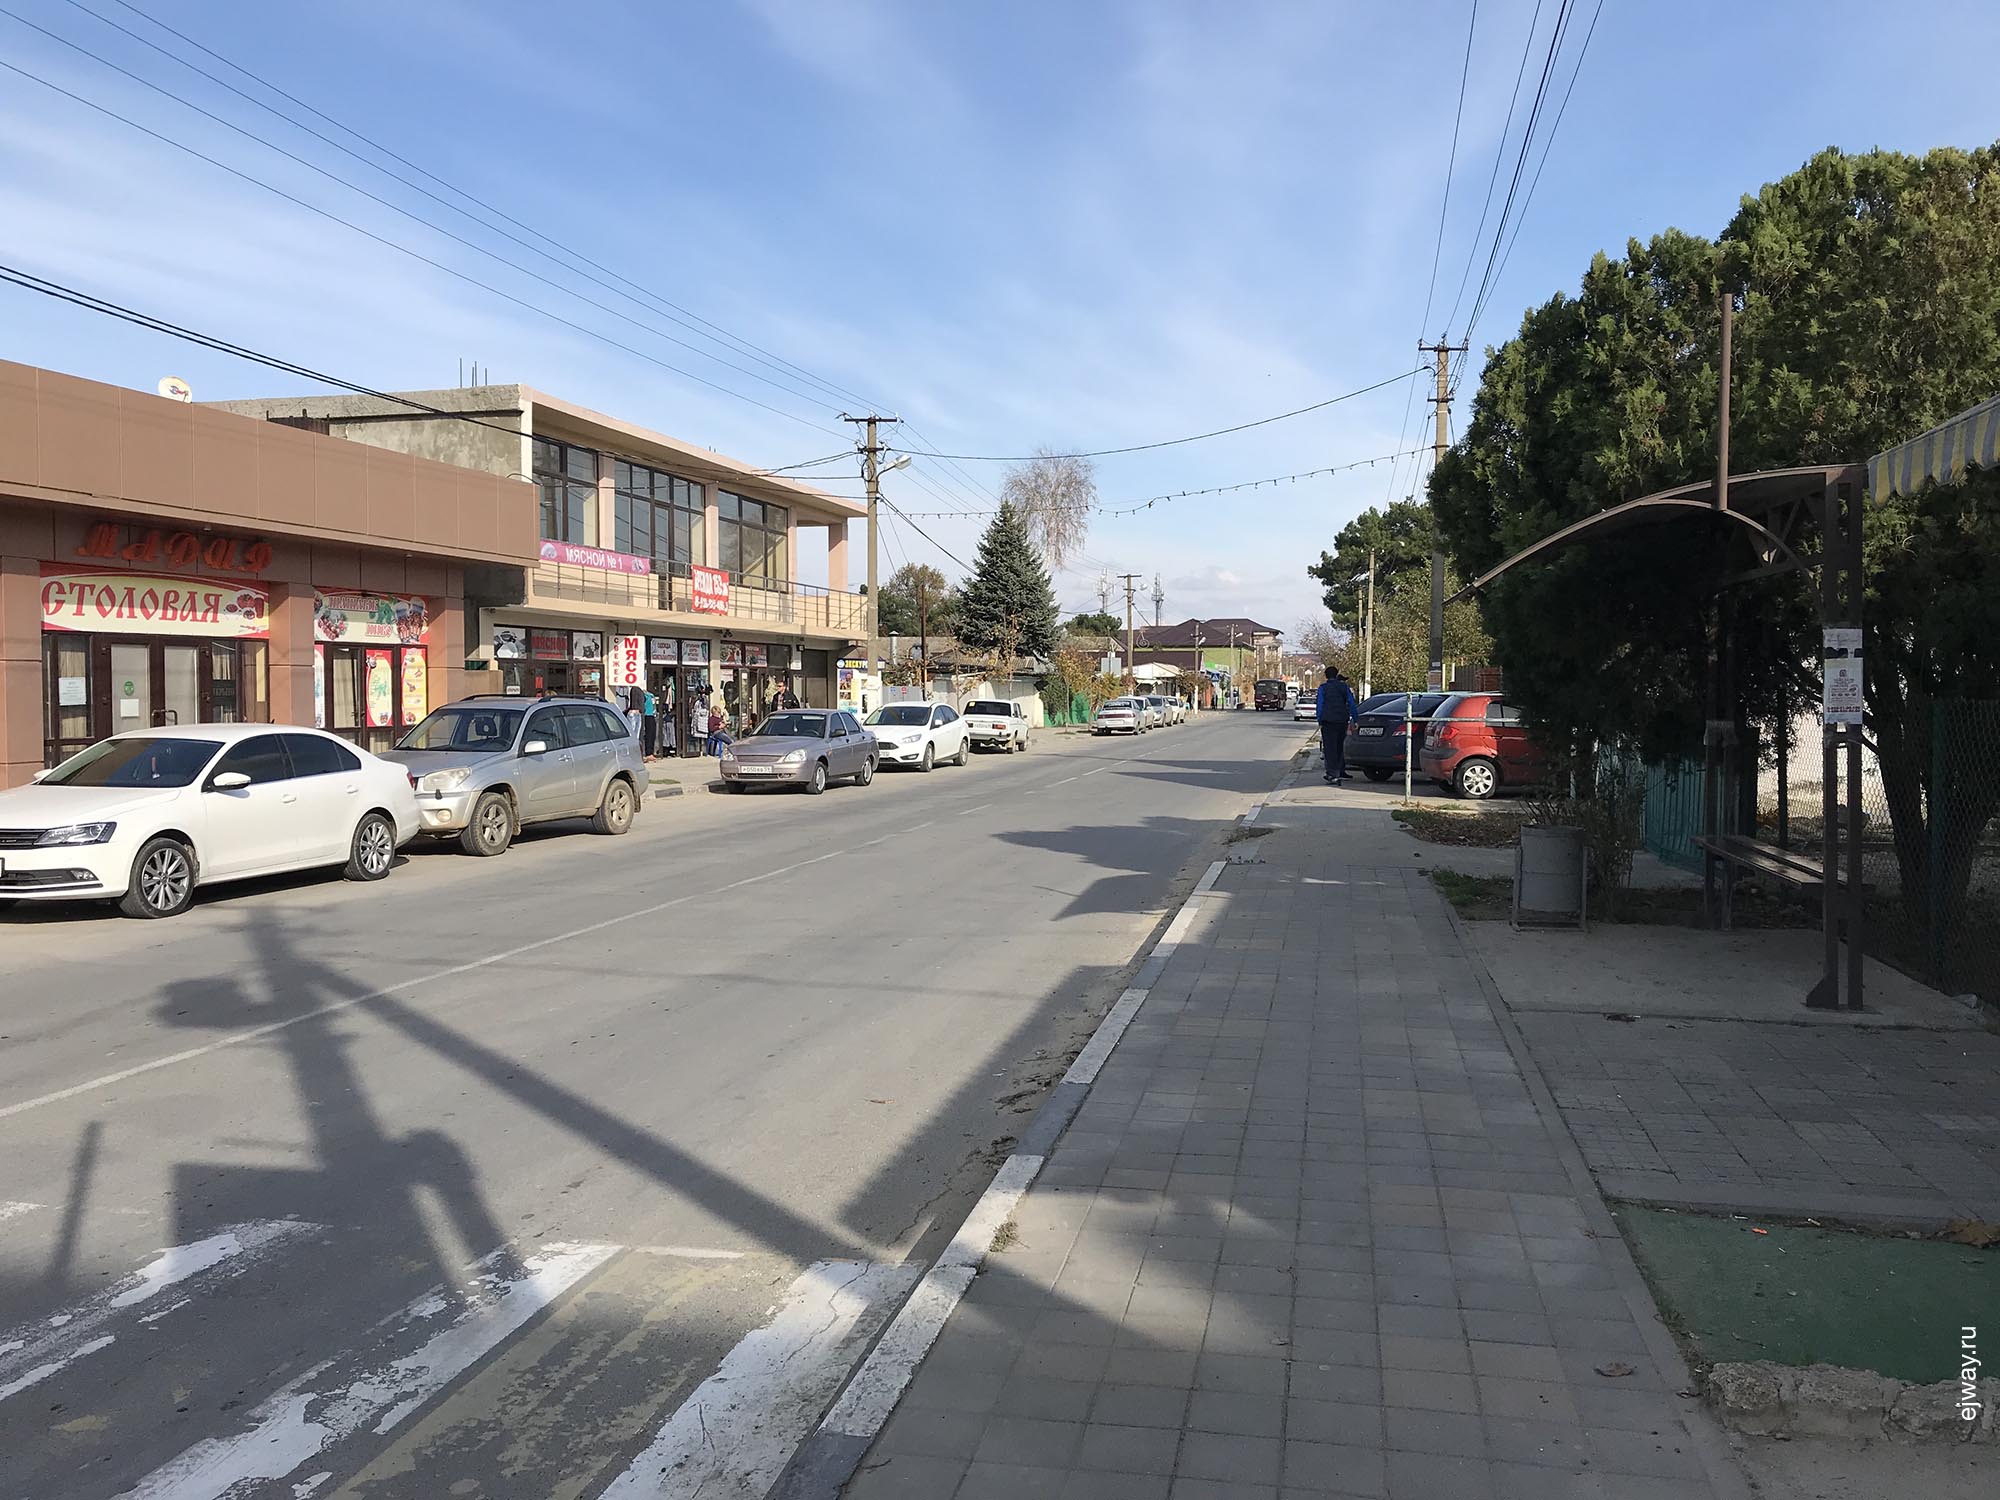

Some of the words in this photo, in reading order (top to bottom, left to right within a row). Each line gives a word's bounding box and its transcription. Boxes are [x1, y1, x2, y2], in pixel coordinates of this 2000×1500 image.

[565, 547, 605, 568] МЯСНОЙ
[607, 556, 617, 568] №
[618, 558, 623, 569] 1
[41, 580, 223, 624] СТОЛОВАЯ
[624, 637, 638, 684] МЯСО
